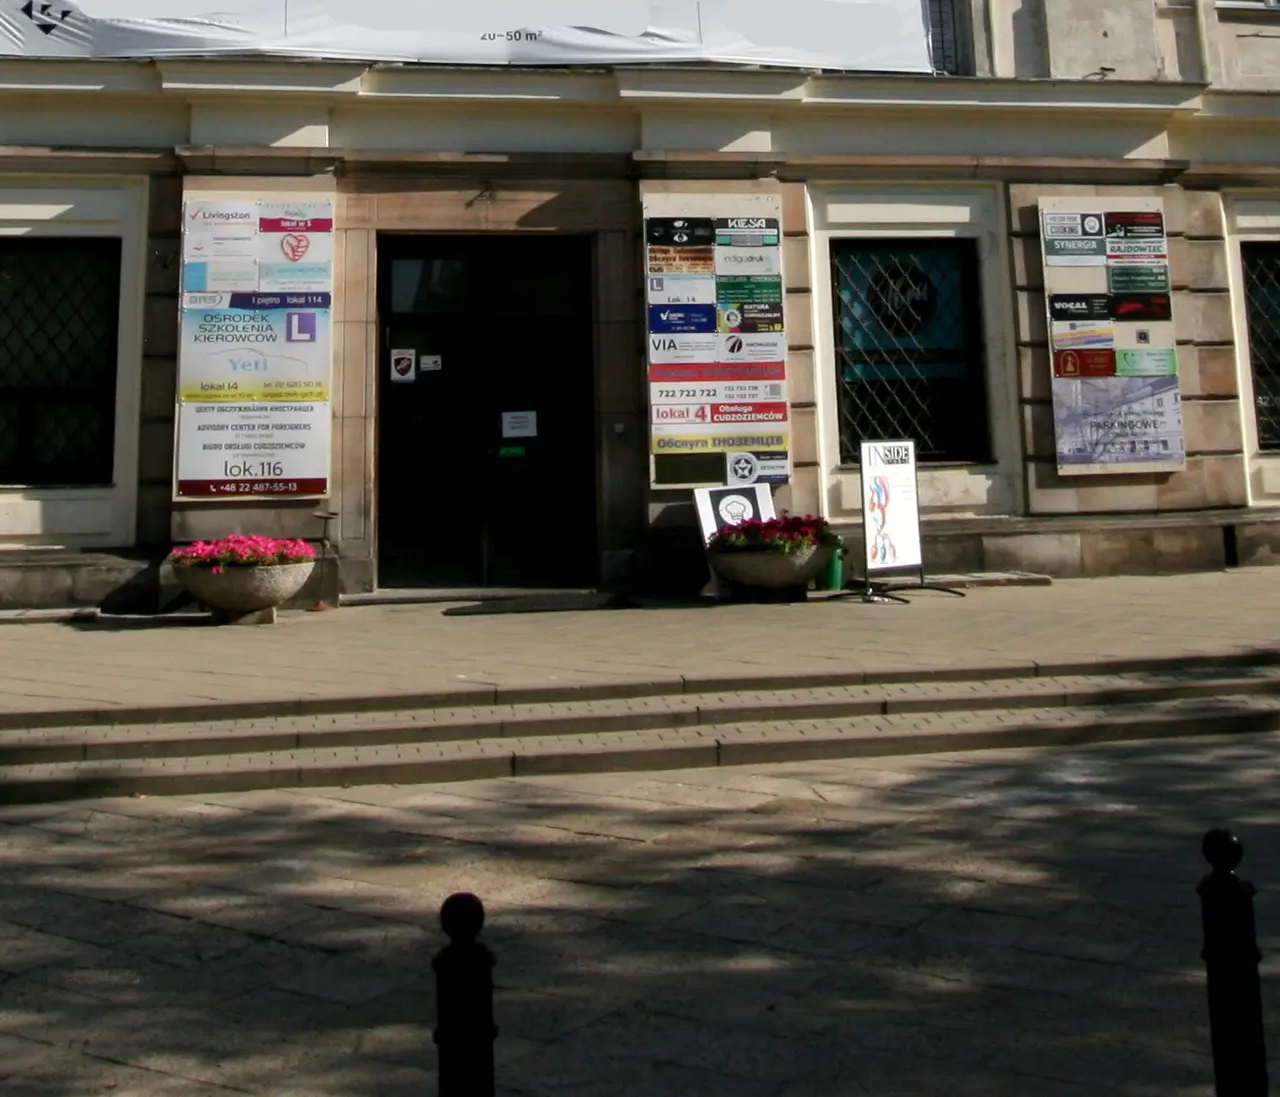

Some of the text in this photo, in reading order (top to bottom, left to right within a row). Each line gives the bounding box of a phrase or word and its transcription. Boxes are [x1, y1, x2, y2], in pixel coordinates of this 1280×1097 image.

[203, 212, 250, 221] Livingston
[1054, 240, 1097, 249] SYNERGIA
[198, 323, 274, 333] SZKOLENIA
[291, 314, 311, 340] L
[651, 339, 678, 351] VIA
[228, 358, 268, 371] Yeti
[201, 382, 225, 391] lokal
[228, 382, 238, 390] 14
[658, 389, 717, 398] 722 722 722
[656, 406, 708, 422] lokal 4
[719, 405, 753, 413] Obsługa
[713, 410, 783, 422] CUDZOZIEMCÓW
[257, 423, 270, 431] FOR
[271, 423, 311, 431] FOREIGNERS
[253, 441, 306, 450] CUDZOZIEMCÓW
[224, 461, 283, 477] lok.116
[220, 482, 297, 492] +48 22 487-55-13
